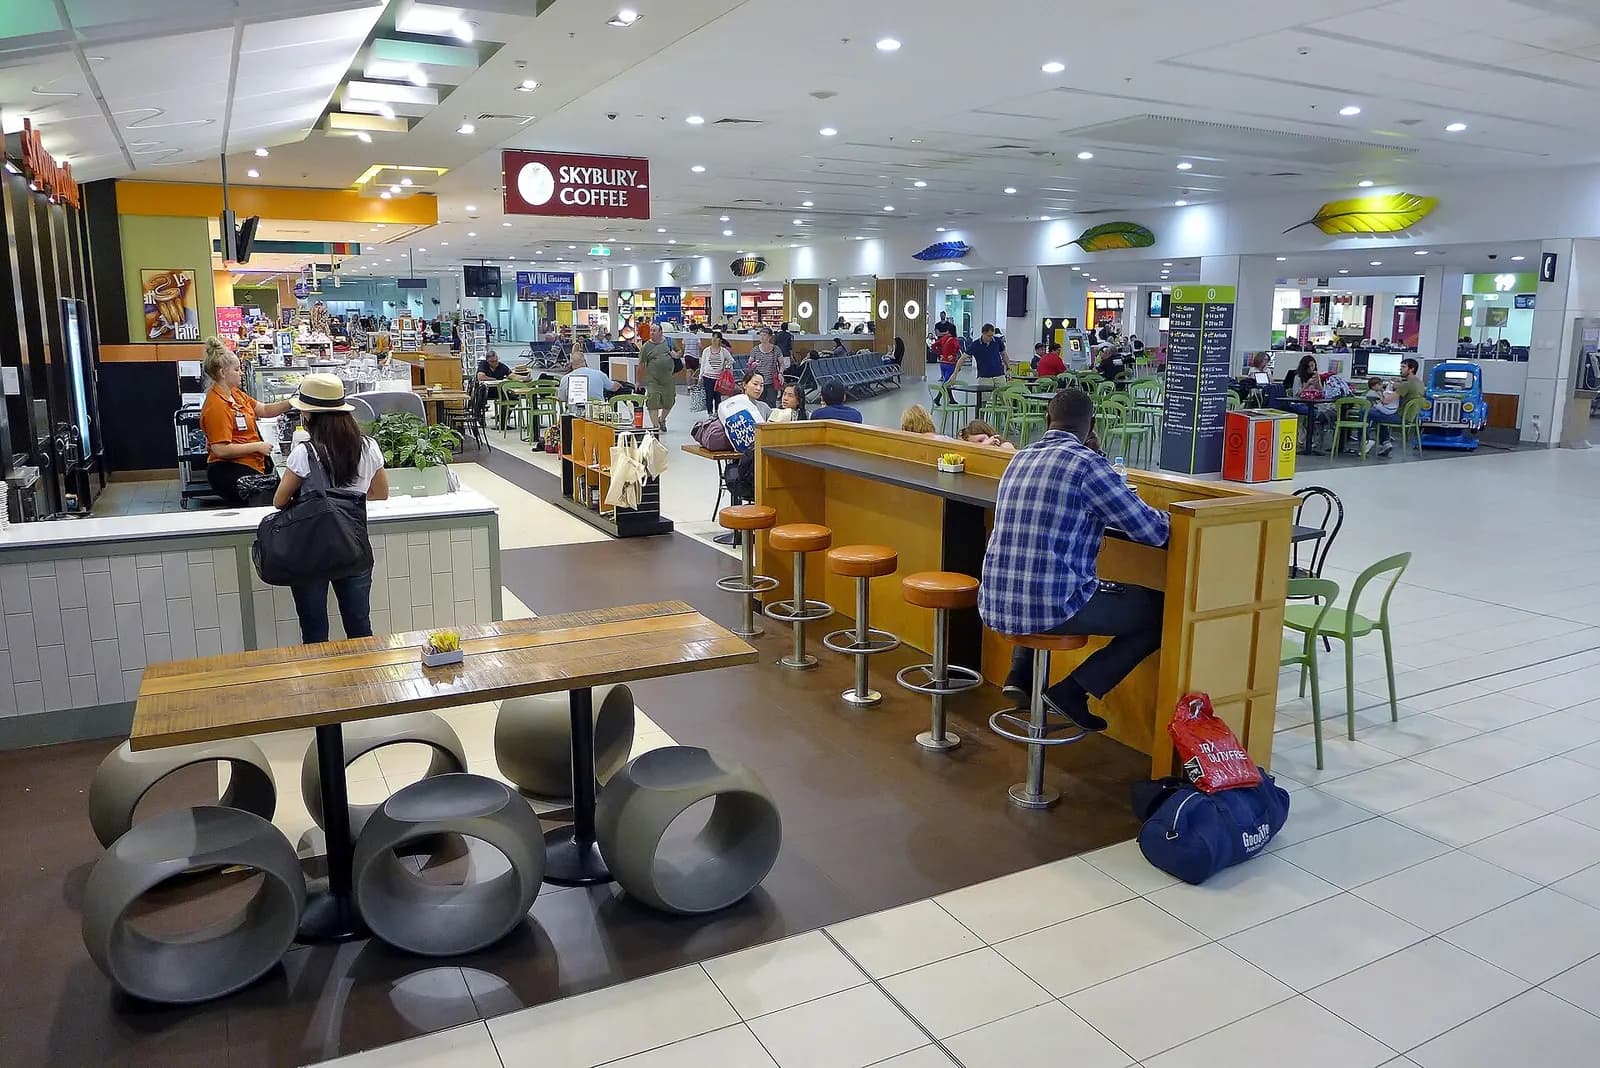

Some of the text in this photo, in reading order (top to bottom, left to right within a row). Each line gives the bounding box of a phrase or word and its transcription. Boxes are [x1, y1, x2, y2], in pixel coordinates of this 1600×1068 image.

[559, 166, 638, 187] SKYBURY
[559, 187, 629, 207] COFFEE
[528, 273, 548, 285] WIN
[660, 295, 680, 305] ATM
